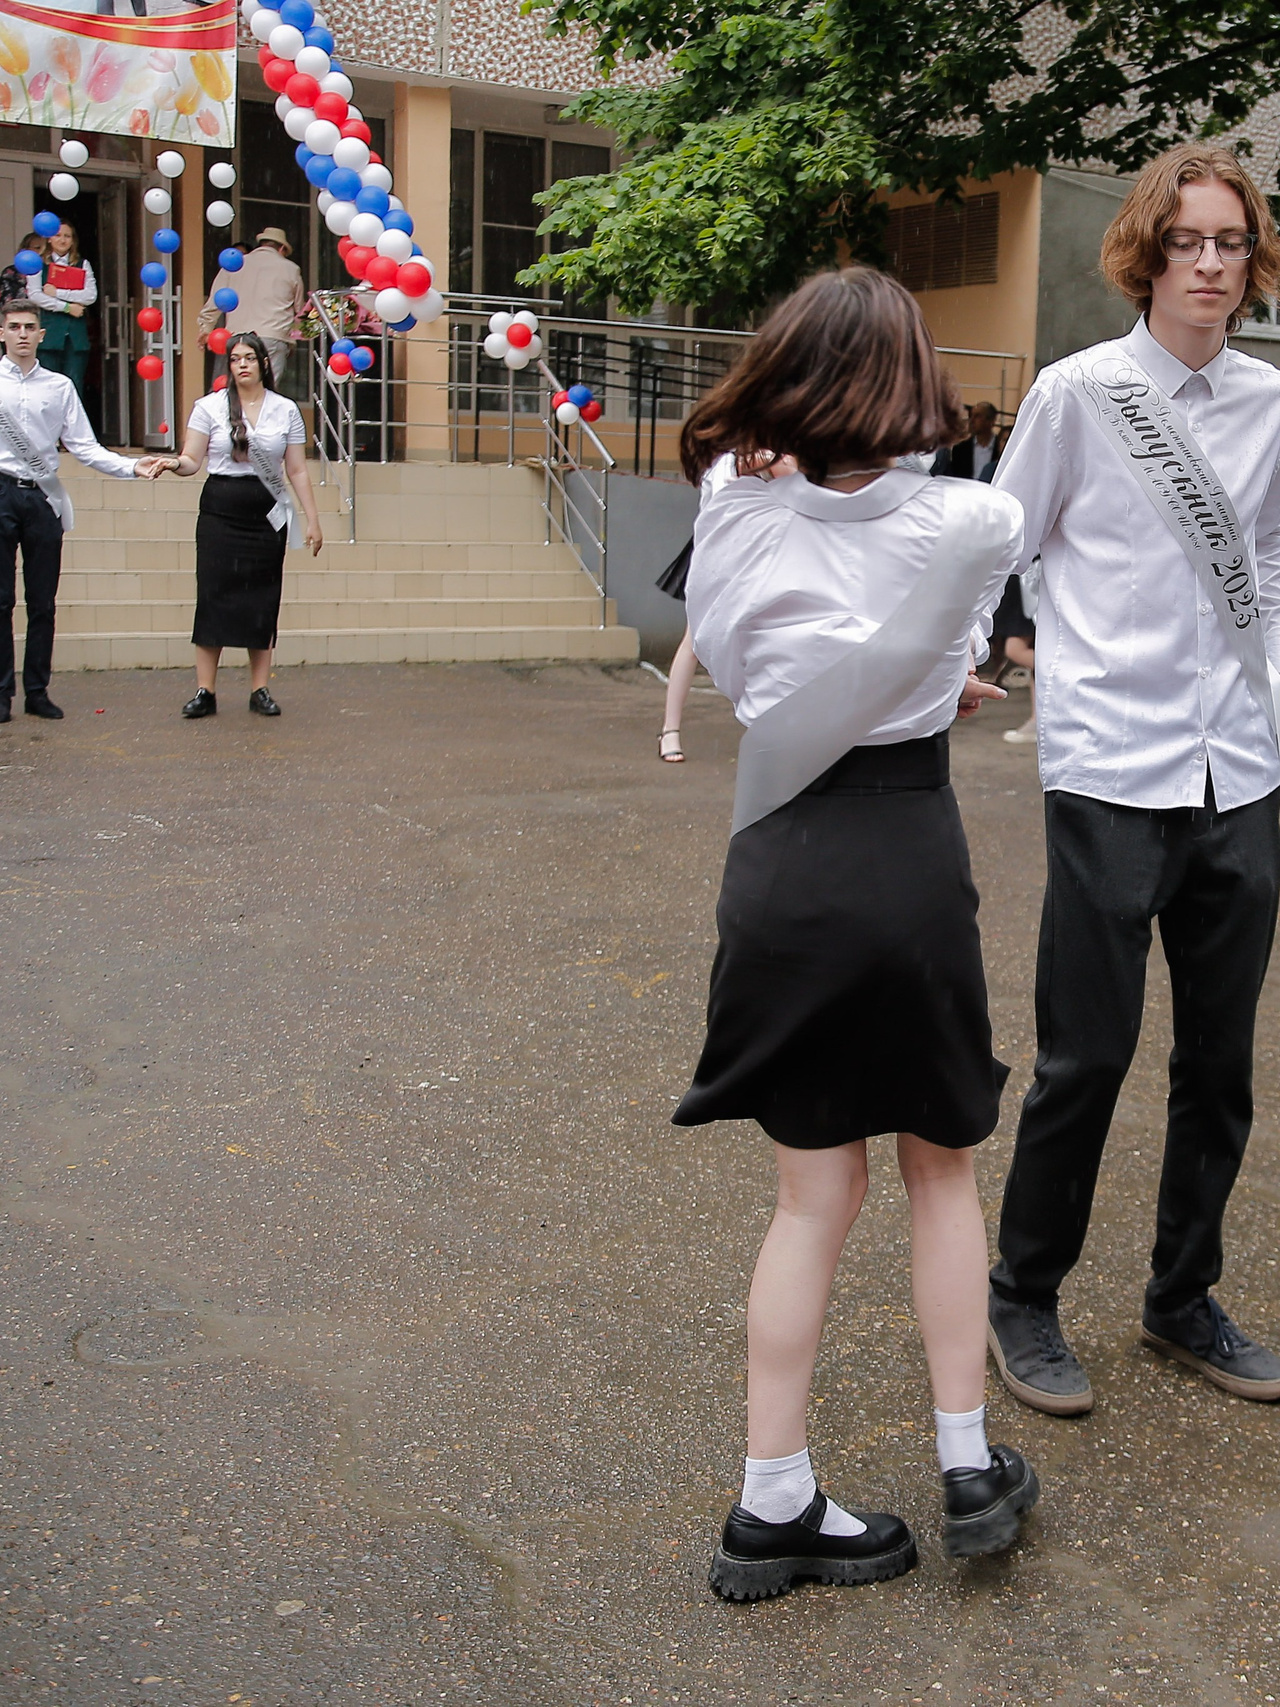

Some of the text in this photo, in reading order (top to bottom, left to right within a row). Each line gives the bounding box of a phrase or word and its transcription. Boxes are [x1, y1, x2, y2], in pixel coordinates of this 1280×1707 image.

[24, 455, 50, 478] 2023
[1117, 429, 1134, 448] класс
[1091, 358, 1260, 630] Выпускник 2023
[1140, 463, 1173, 497] МАОУ
[1167, 497, 1192, 527] СОШ
[1207, 485, 1240, 542] Дмитрий
